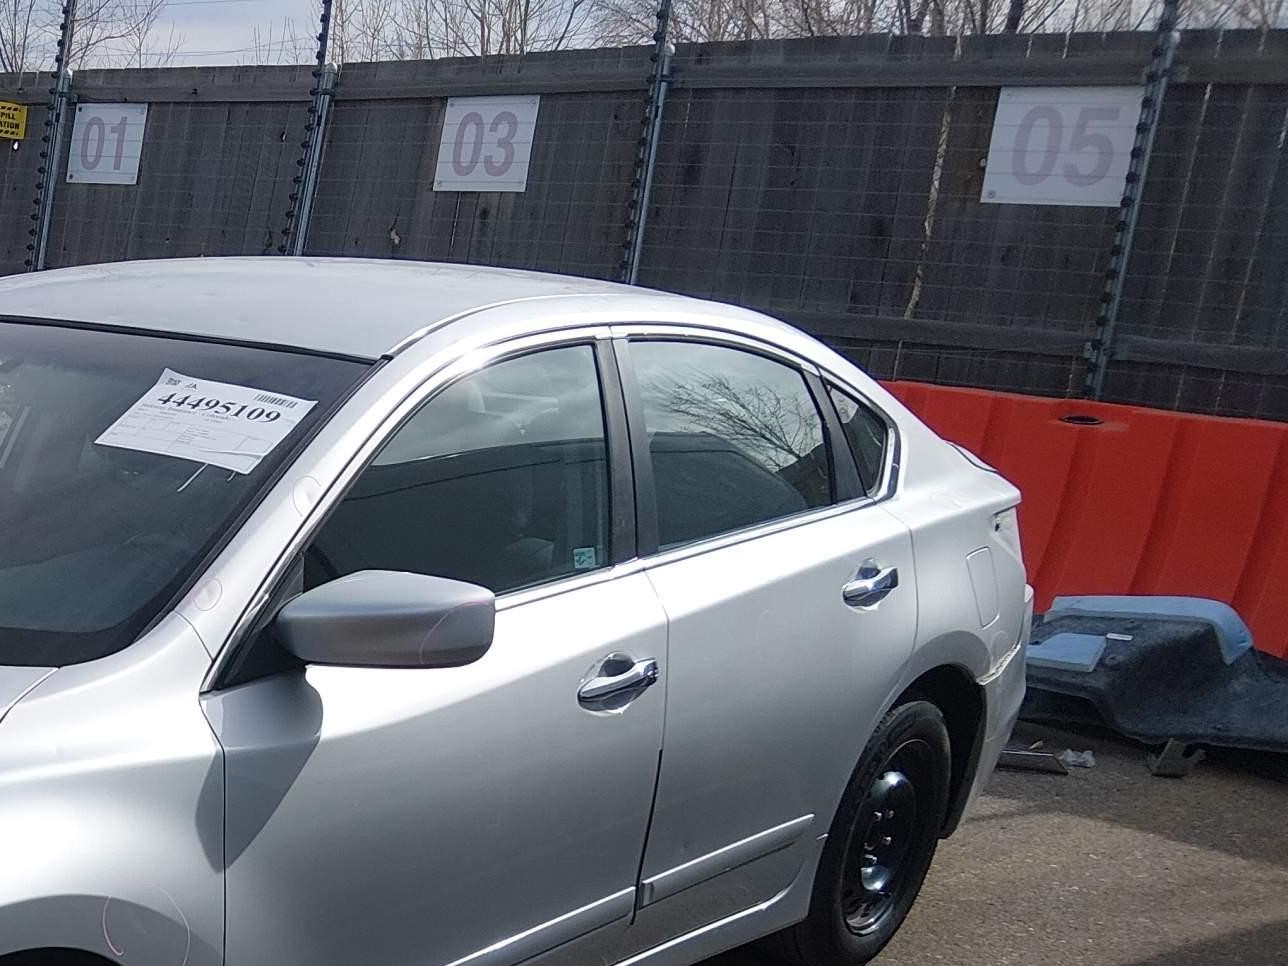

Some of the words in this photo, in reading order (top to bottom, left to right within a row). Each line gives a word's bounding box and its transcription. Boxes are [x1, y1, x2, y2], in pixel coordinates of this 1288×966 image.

[79, 115, 128, 171] 01
[452, 110, 519, 177] 03
[1012, 105, 1120, 188] 05
[157, 392, 282, 424] 44495109
